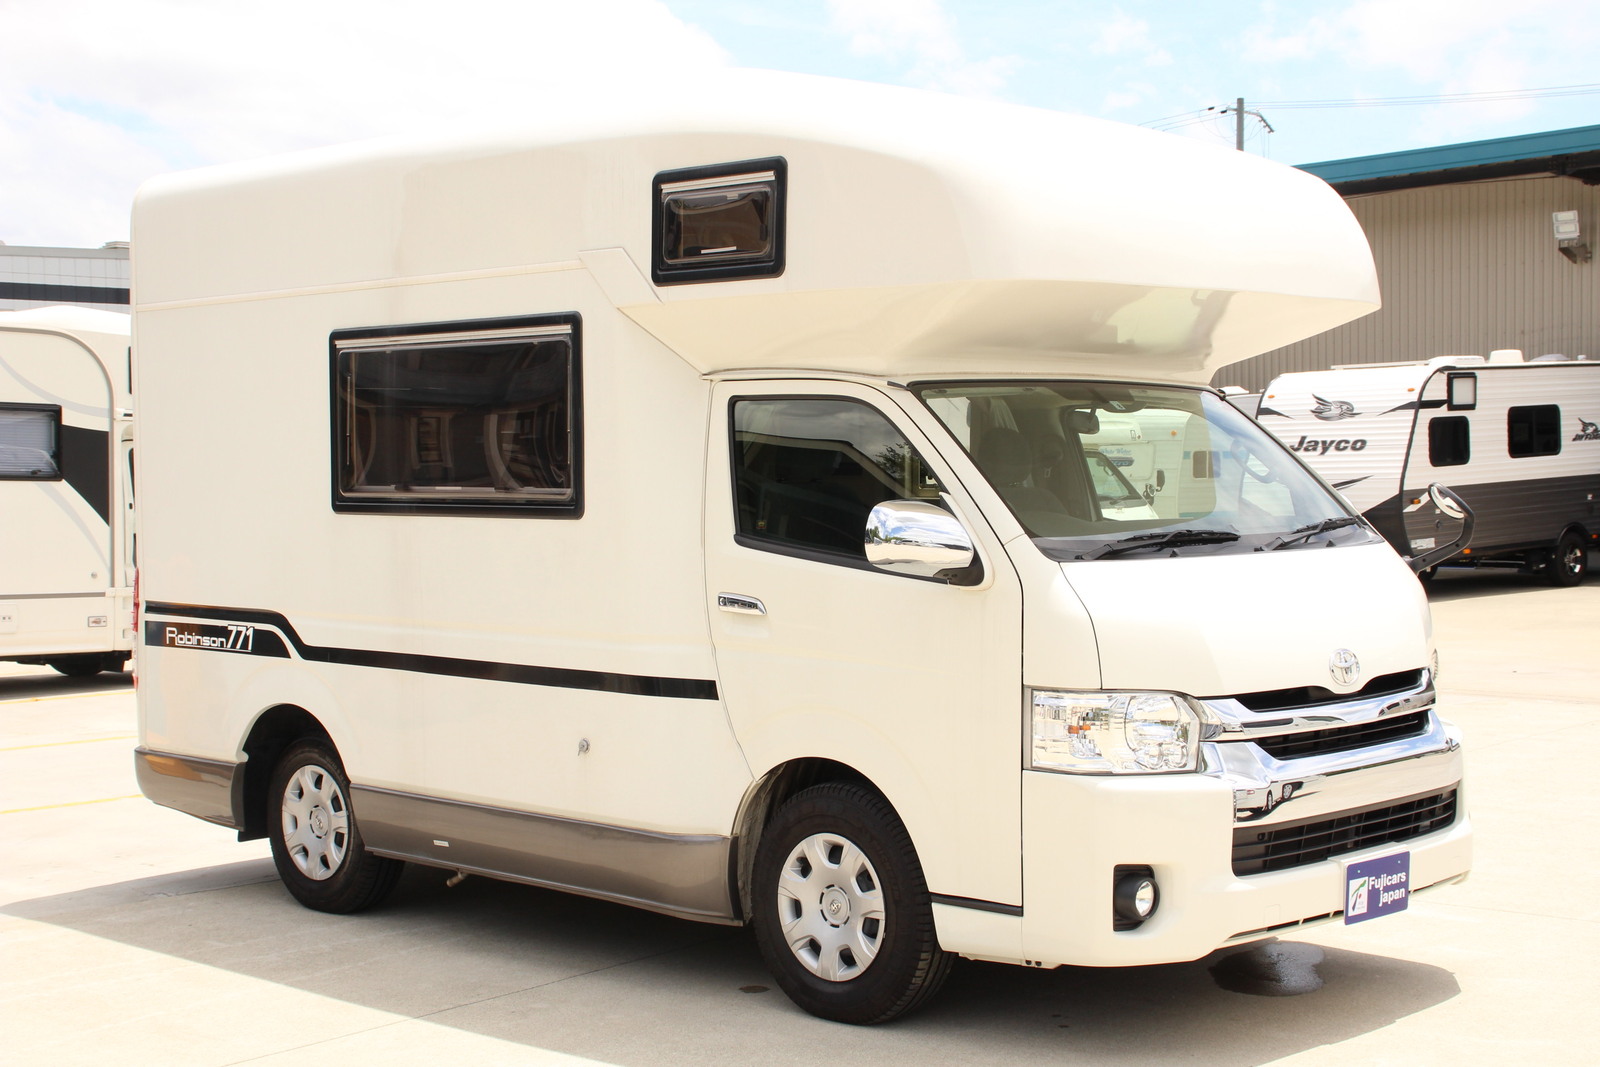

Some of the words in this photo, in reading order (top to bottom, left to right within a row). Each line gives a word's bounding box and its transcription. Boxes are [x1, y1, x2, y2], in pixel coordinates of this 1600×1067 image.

[1289, 435, 1367, 456] Jayco
[165, 626, 227, 648] Robinson
[227, 625, 254, 651] 771
[1368, 871, 1407, 891] Fujicars
[1378, 887, 1405, 907] japan
